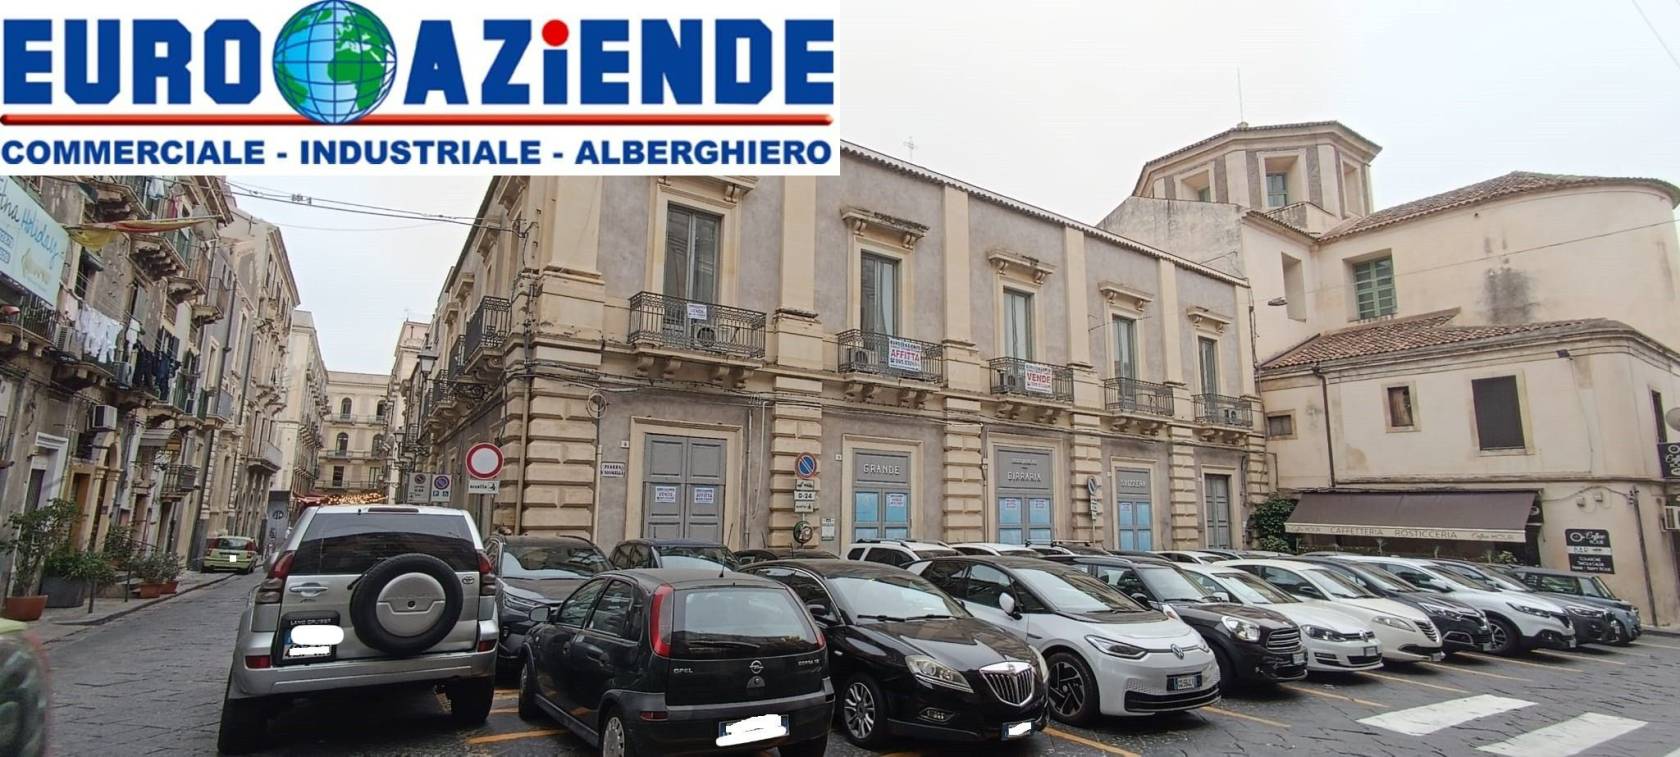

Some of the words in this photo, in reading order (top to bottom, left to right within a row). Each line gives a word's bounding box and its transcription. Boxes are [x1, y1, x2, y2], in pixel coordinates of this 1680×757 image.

[891, 350, 920, 361] AFFITTA
[1027, 372, 1051, 383] VENDE
[863, 463, 900, 475] GRANDE
[1329, 527, 1384, 536] CAFFETTERIA
[1394, 529, 1457, 538] ROSTICCERIA
